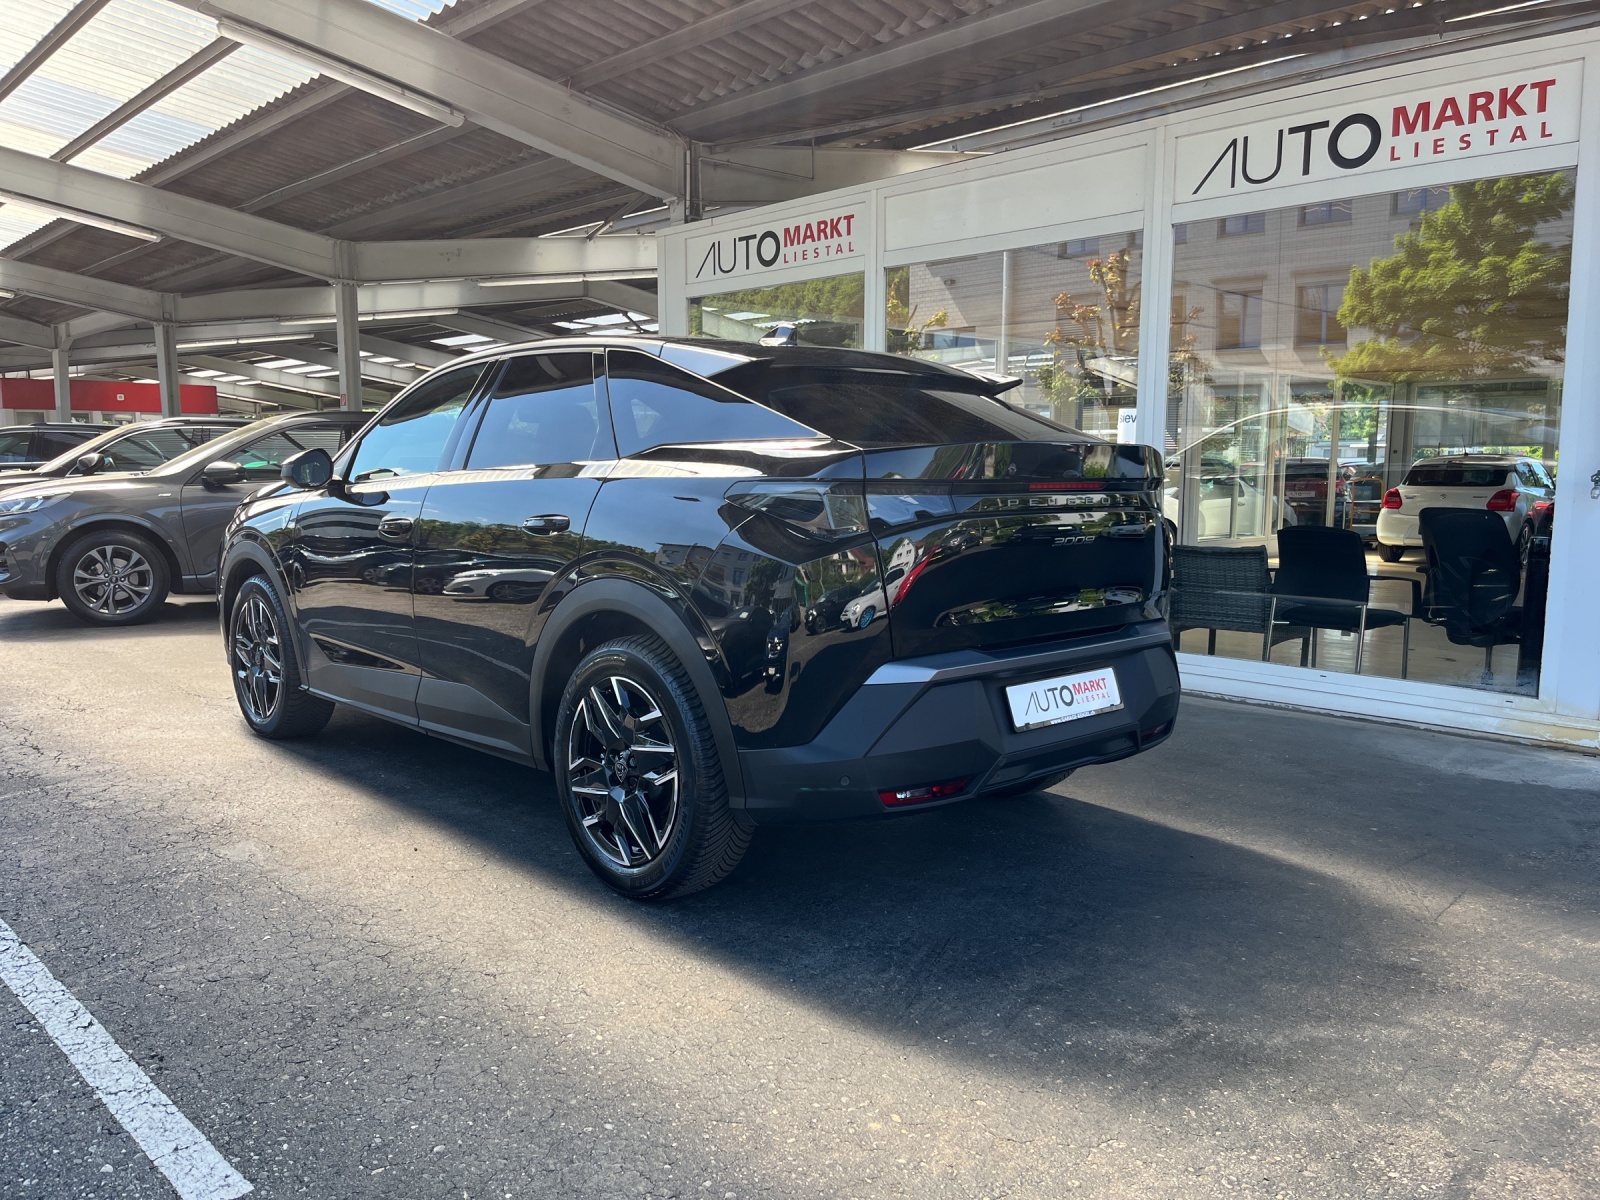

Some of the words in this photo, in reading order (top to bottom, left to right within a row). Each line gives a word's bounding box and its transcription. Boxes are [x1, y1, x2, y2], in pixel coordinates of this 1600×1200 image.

[1191, 112, 1382, 195] AUTO
[1391, 78, 1557, 138] MARKT
[1389, 121, 1553, 162] LIESTAL
[695, 230, 781, 279] AUTO
[783, 213, 855, 248] MARKT
[783, 241, 855, 264] LIESTAL
[1007, 496, 1127, 507] PEUGEOT
[1025, 685, 1074, 716] AUTO
[1072, 678, 1107, 695] MARKT
[1076, 692, 1111, 704] LIESTAL
